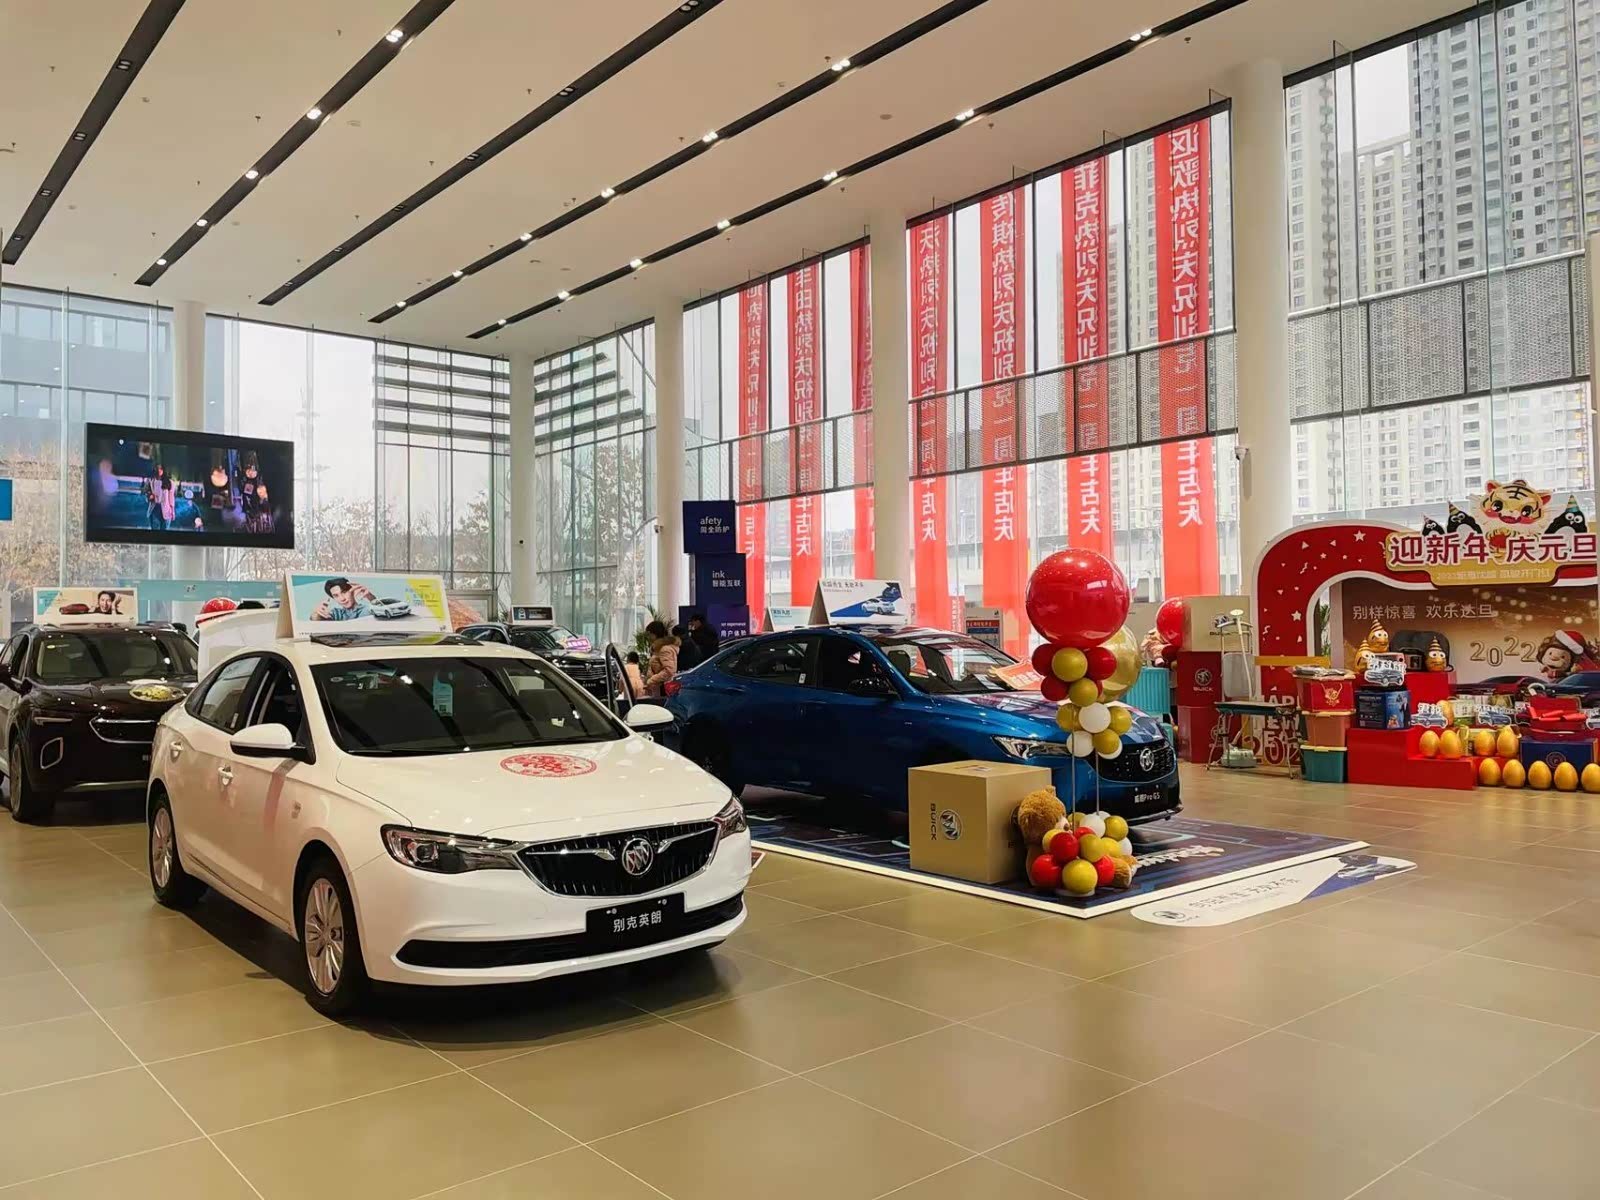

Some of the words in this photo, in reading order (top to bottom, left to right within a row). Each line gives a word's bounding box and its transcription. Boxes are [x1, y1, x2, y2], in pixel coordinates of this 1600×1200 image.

[700, 516, 722, 526] afety
[1390, 532, 1489, 565] 迎新年
[1506, 534, 1597, 563] 庆元旦
[712, 570, 725, 579] ink
[1353, 605, 1417, 621] 别样惊喜
[1425, 603, 1494, 620] 欢乐达旦
[1470, 635, 1537, 667] 2022
[613, 910, 662, 933] 别克英朗
